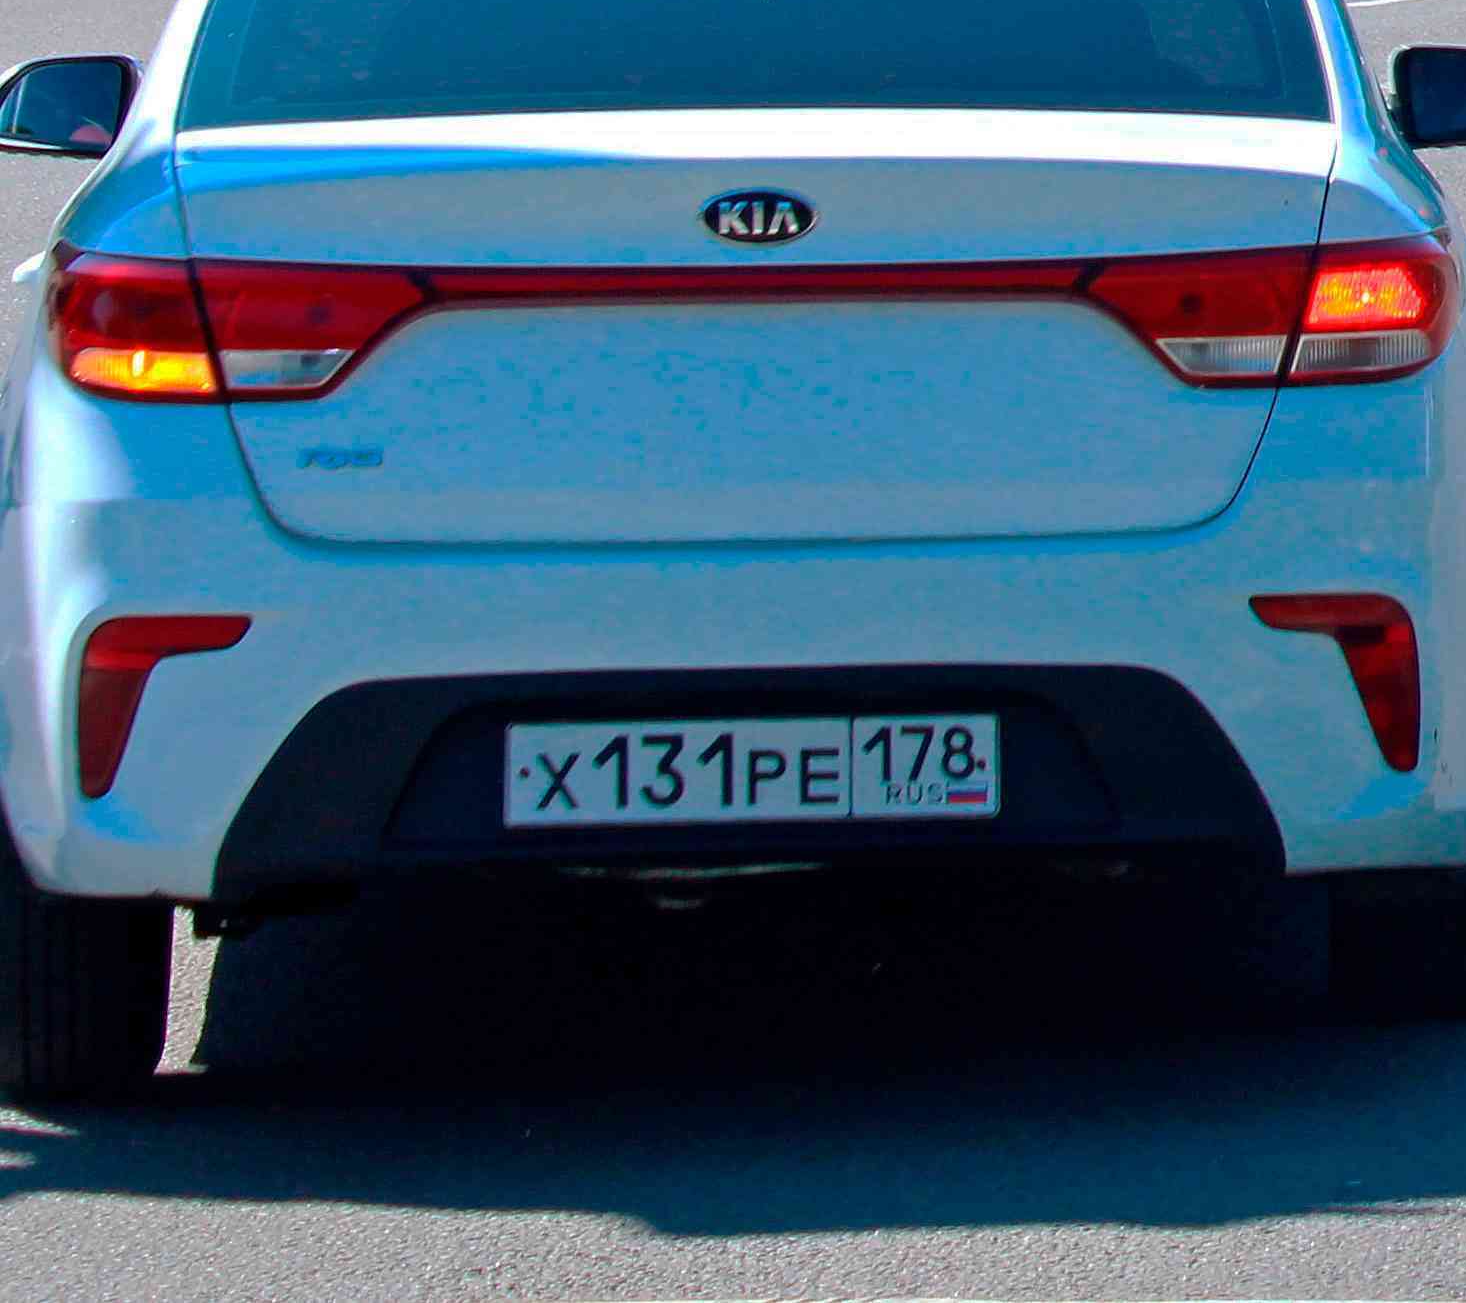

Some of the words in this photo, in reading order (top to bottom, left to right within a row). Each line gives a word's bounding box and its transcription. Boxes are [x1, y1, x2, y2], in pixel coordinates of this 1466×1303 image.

[718, 201, 800, 235] KIA
[862, 724, 974, 782] 178
[885, 779, 945, 806] RUS
